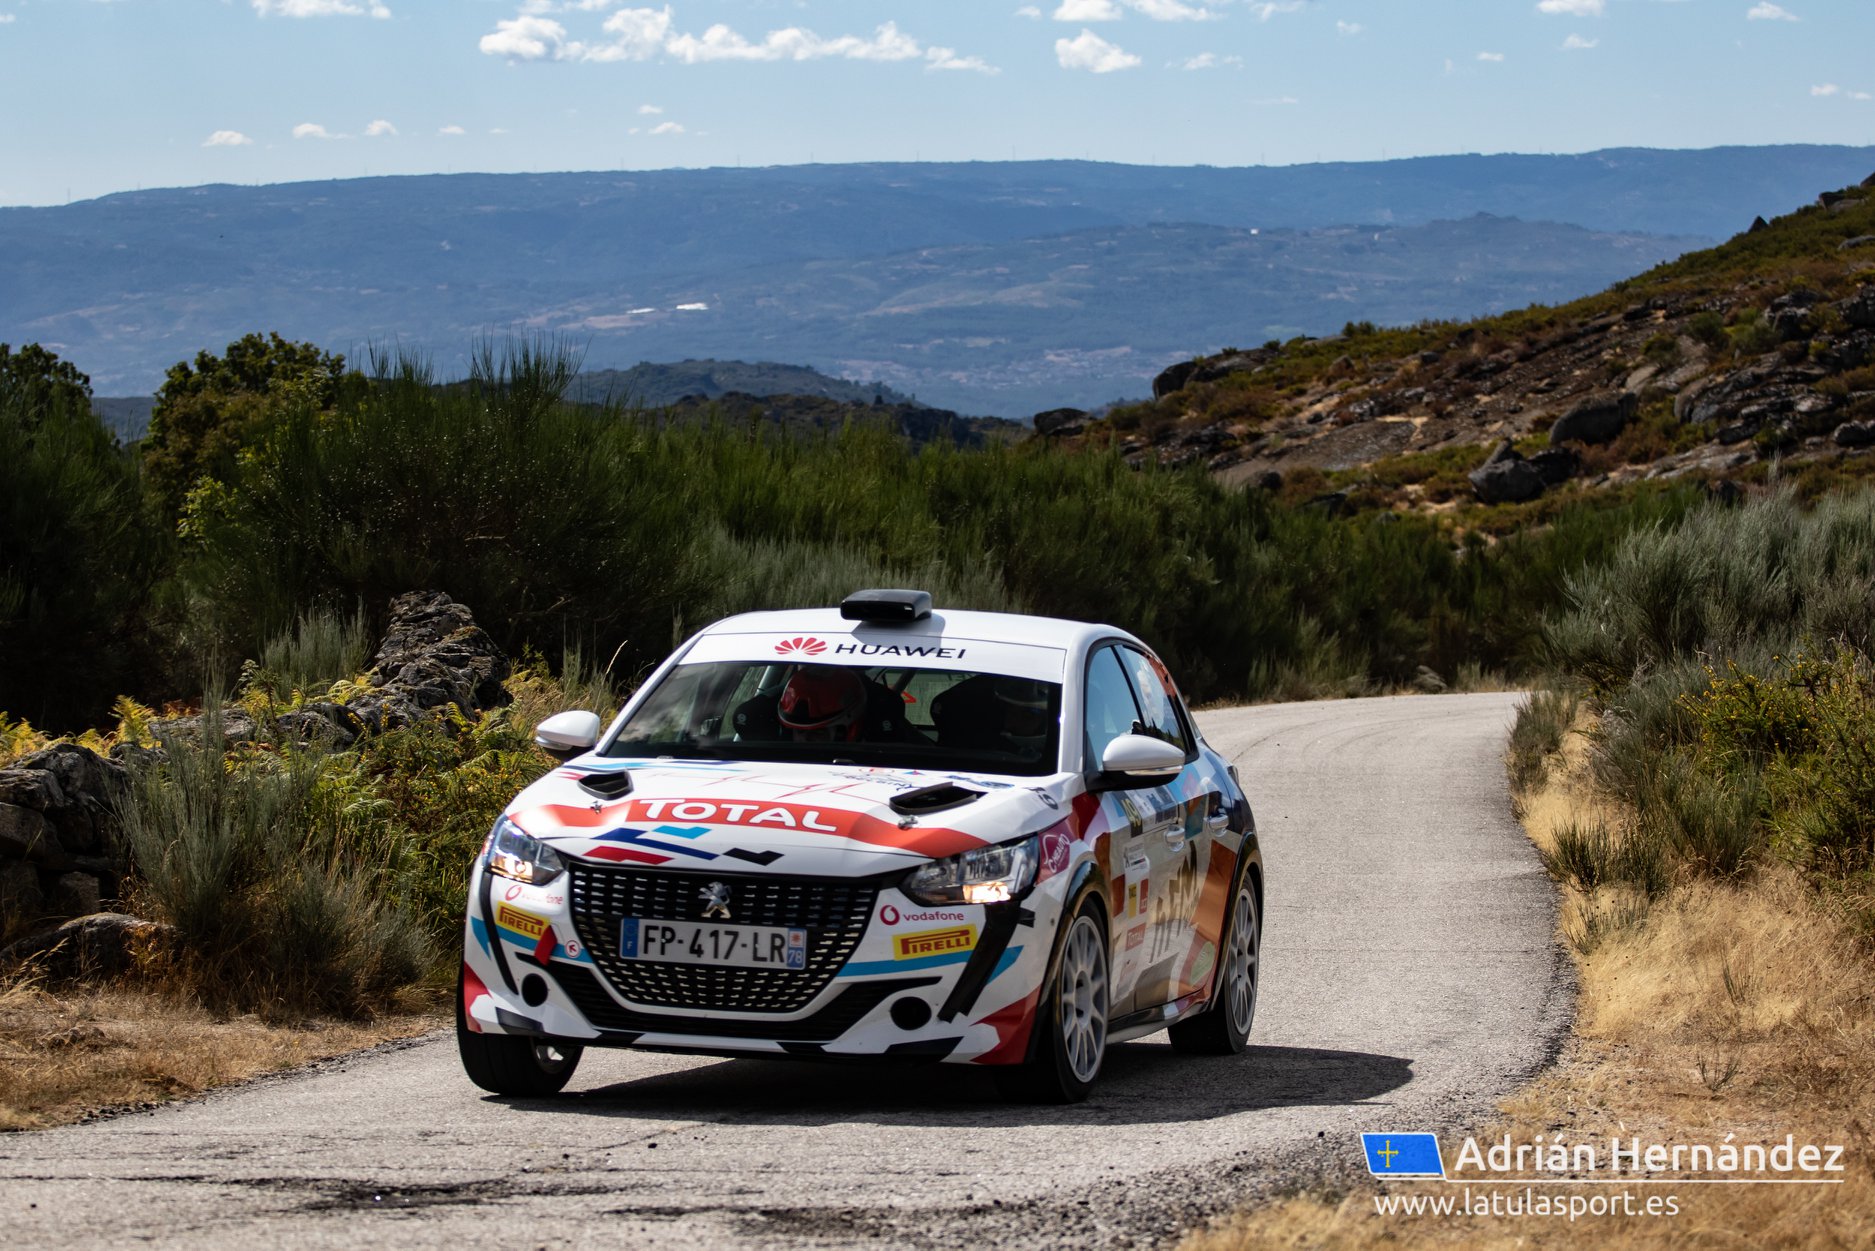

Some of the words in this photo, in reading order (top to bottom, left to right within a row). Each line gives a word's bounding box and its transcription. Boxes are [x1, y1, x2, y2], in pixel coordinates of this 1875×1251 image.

[834, 643, 966, 659] HUAWEI
[640, 799, 837, 832] TOTAL
[499, 905, 544, 936] PIRELLI
[903, 911, 964, 921] vodafone
[627, 941, 633, 950] F
[642, 924, 786, 963] FP-417-LR
[788, 949, 803, 964] 78
[901, 929, 970, 955] PIRELLI
